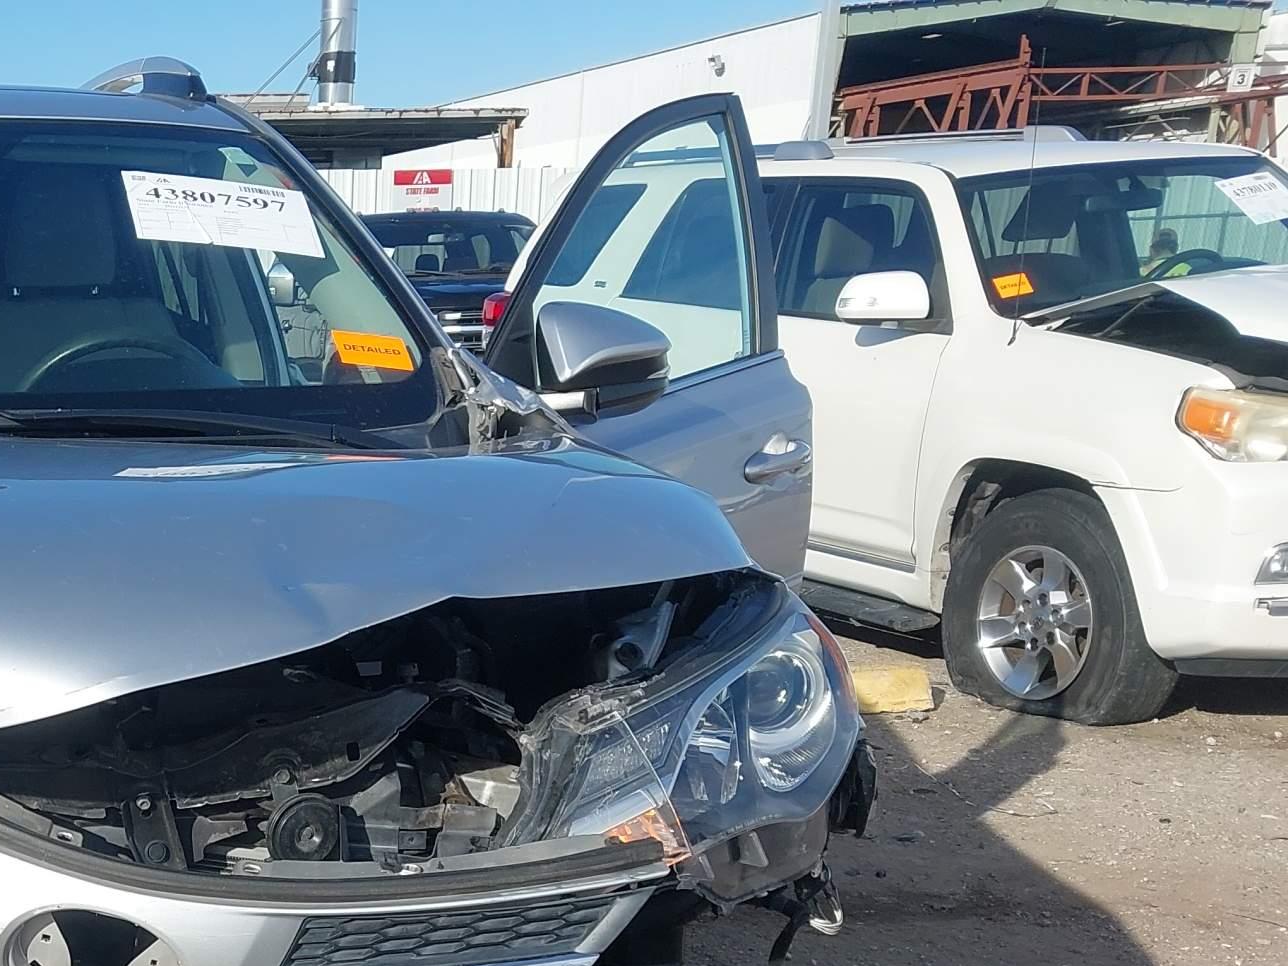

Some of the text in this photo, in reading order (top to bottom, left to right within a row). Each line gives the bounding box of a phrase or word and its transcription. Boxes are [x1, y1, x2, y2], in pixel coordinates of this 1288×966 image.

[1237, 73, 1246, 85] 3
[145, 187, 287, 213] 43807597
[343, 343, 401, 356] DETAILED
